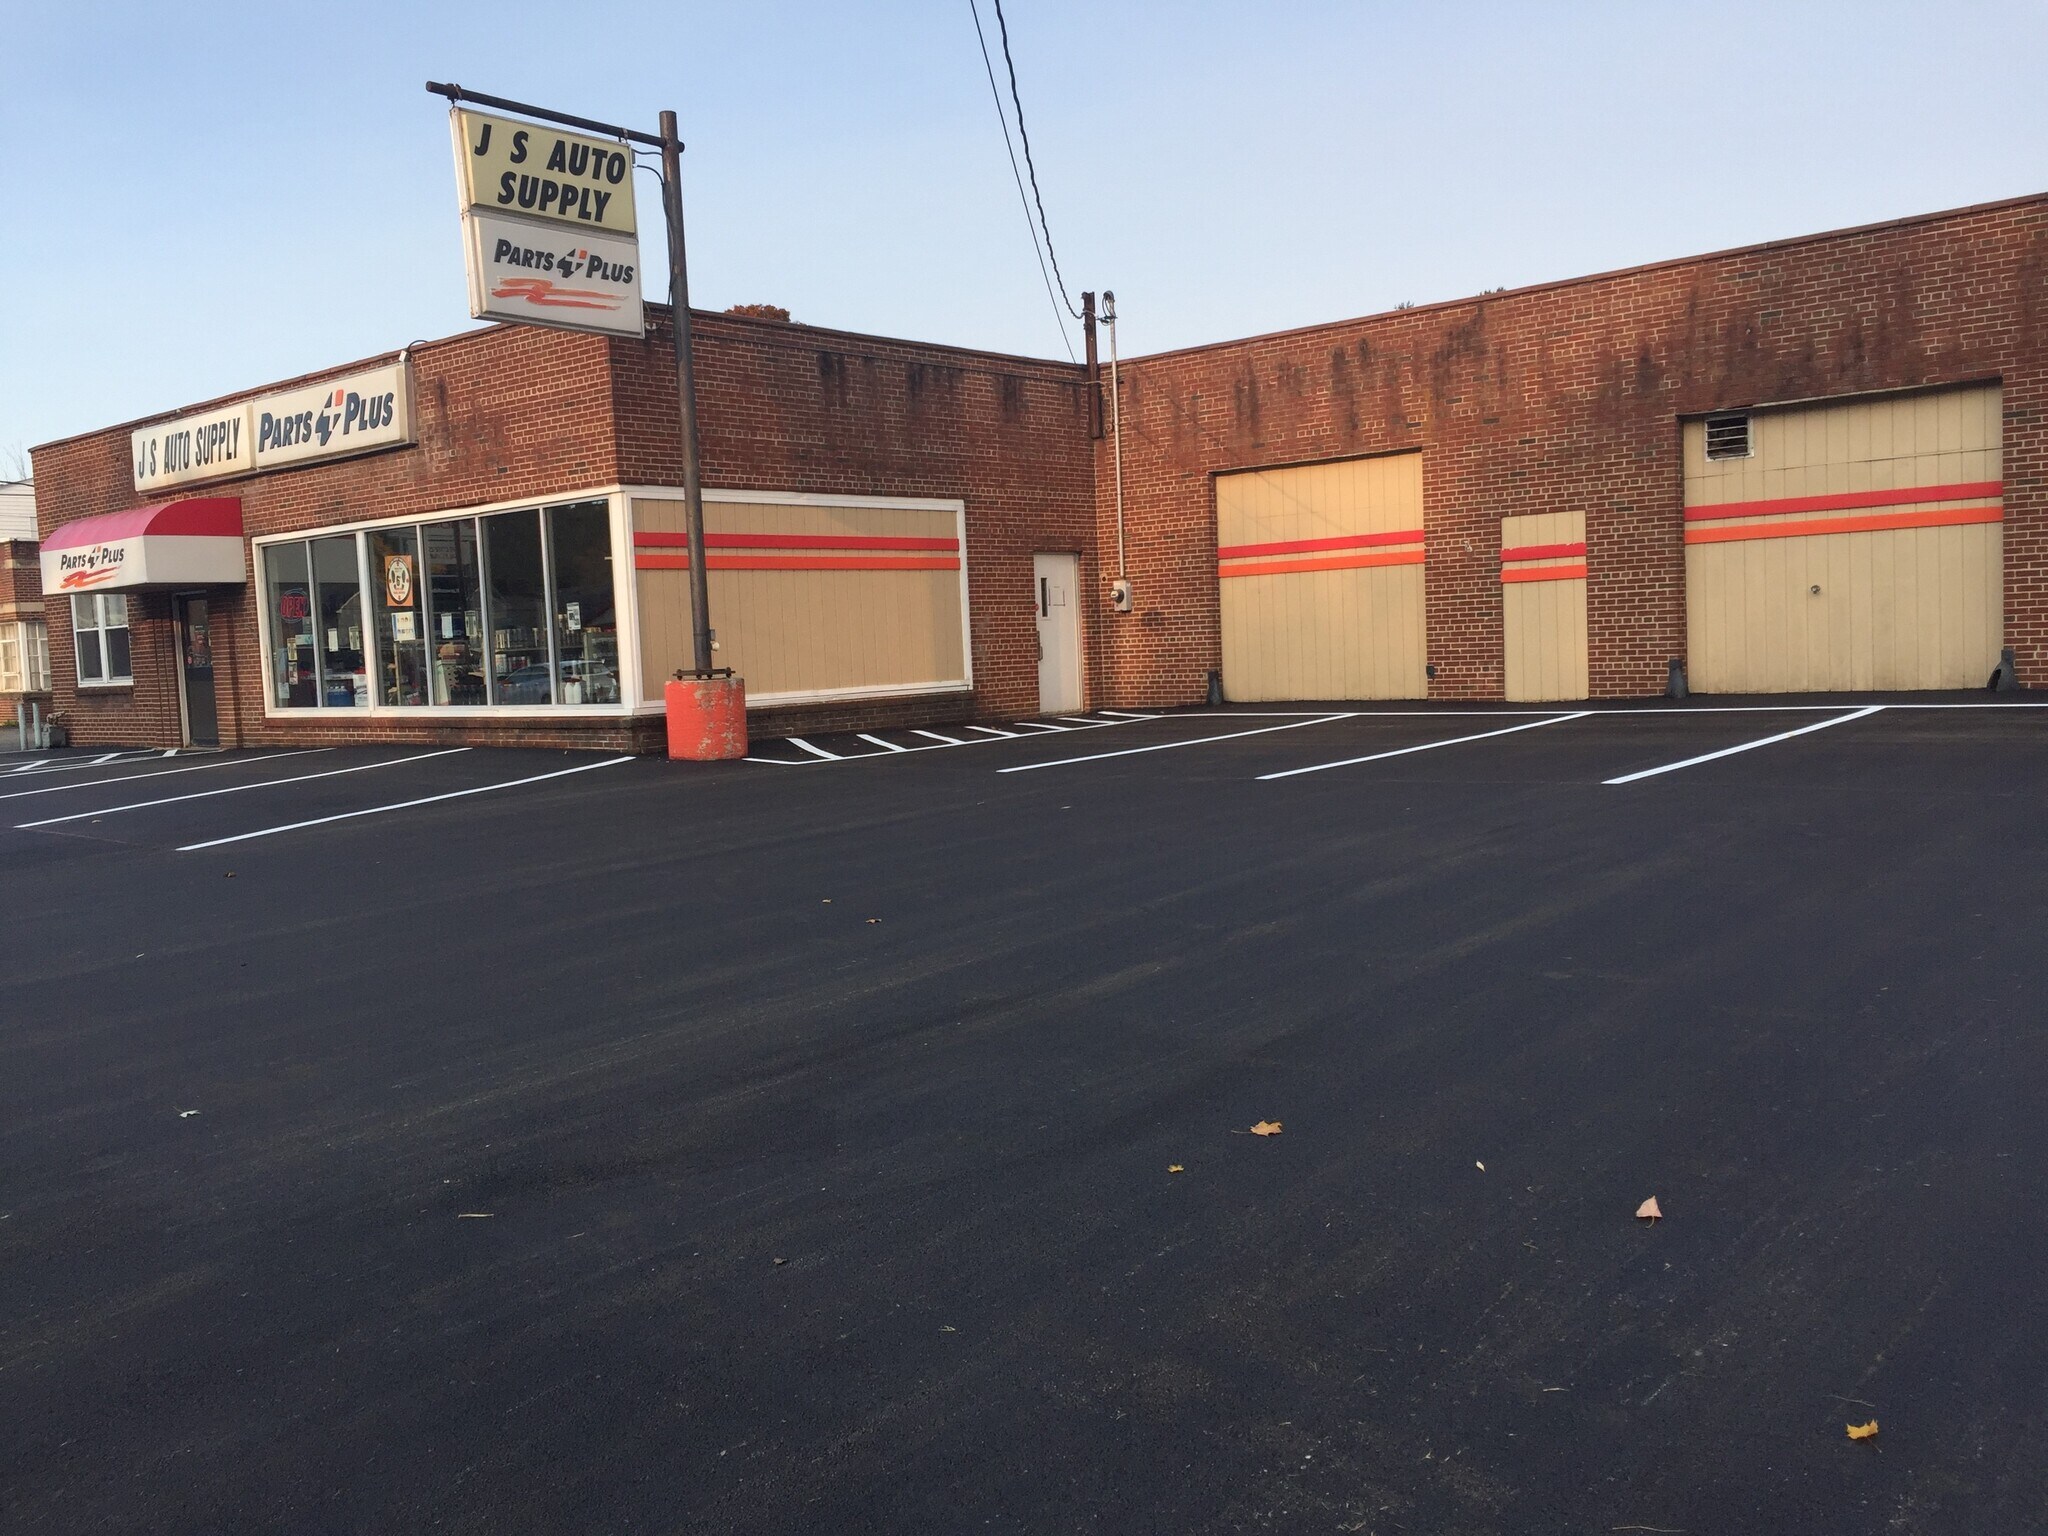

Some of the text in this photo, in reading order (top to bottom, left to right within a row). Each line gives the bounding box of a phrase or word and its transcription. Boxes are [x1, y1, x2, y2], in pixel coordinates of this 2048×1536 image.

[474, 123, 626, 184] J S AUTO
[497, 171, 612, 222] SUPPLY
[494, 239, 634, 284] PARTS PLUS
[138, 417, 241, 479] J S AUTO SUPPLY
[258, 392, 395, 453] PARTS PLUS
[60, 547, 125, 570] PARTS PLUS
